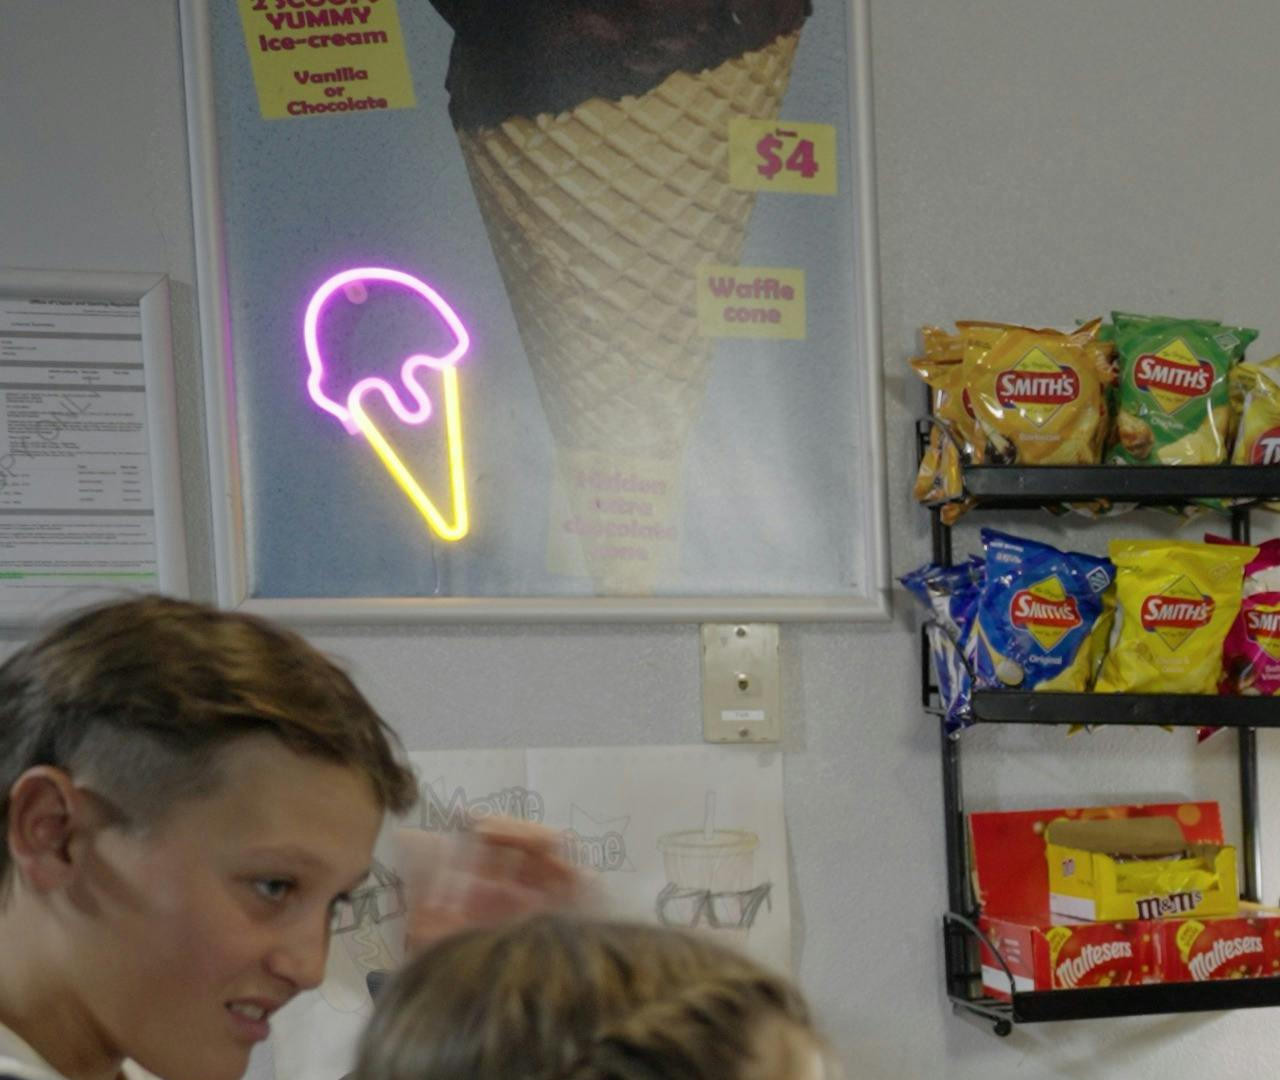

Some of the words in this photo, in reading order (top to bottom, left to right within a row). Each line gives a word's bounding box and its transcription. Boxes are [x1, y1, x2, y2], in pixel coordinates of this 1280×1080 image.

[266, 6, 372, 30] YUMMY
[259, 30, 388, 52] Ice-cream
[294, 67, 368, 85] Vanilla
[324, 86, 345, 98] or
[287, 97, 388, 116] Chocolate
[756, 133, 819, 181] $4
[708, 276, 795, 300] Waffle
[723, 307, 782, 324] cone
[1000, 374, 1074, 396] SMITH'S
[1138, 358, 1210, 390] SMITH'S
[1015, 595, 1075, 620] SMITH'S
[1144, 598, 1211, 621] SMITH'S
[1029, 655, 1063, 665] Original
[561, 829, 626, 871] ime
[1056, 940, 1133, 988] Maltesers
[1188, 936, 1263, 981] Maltesers
